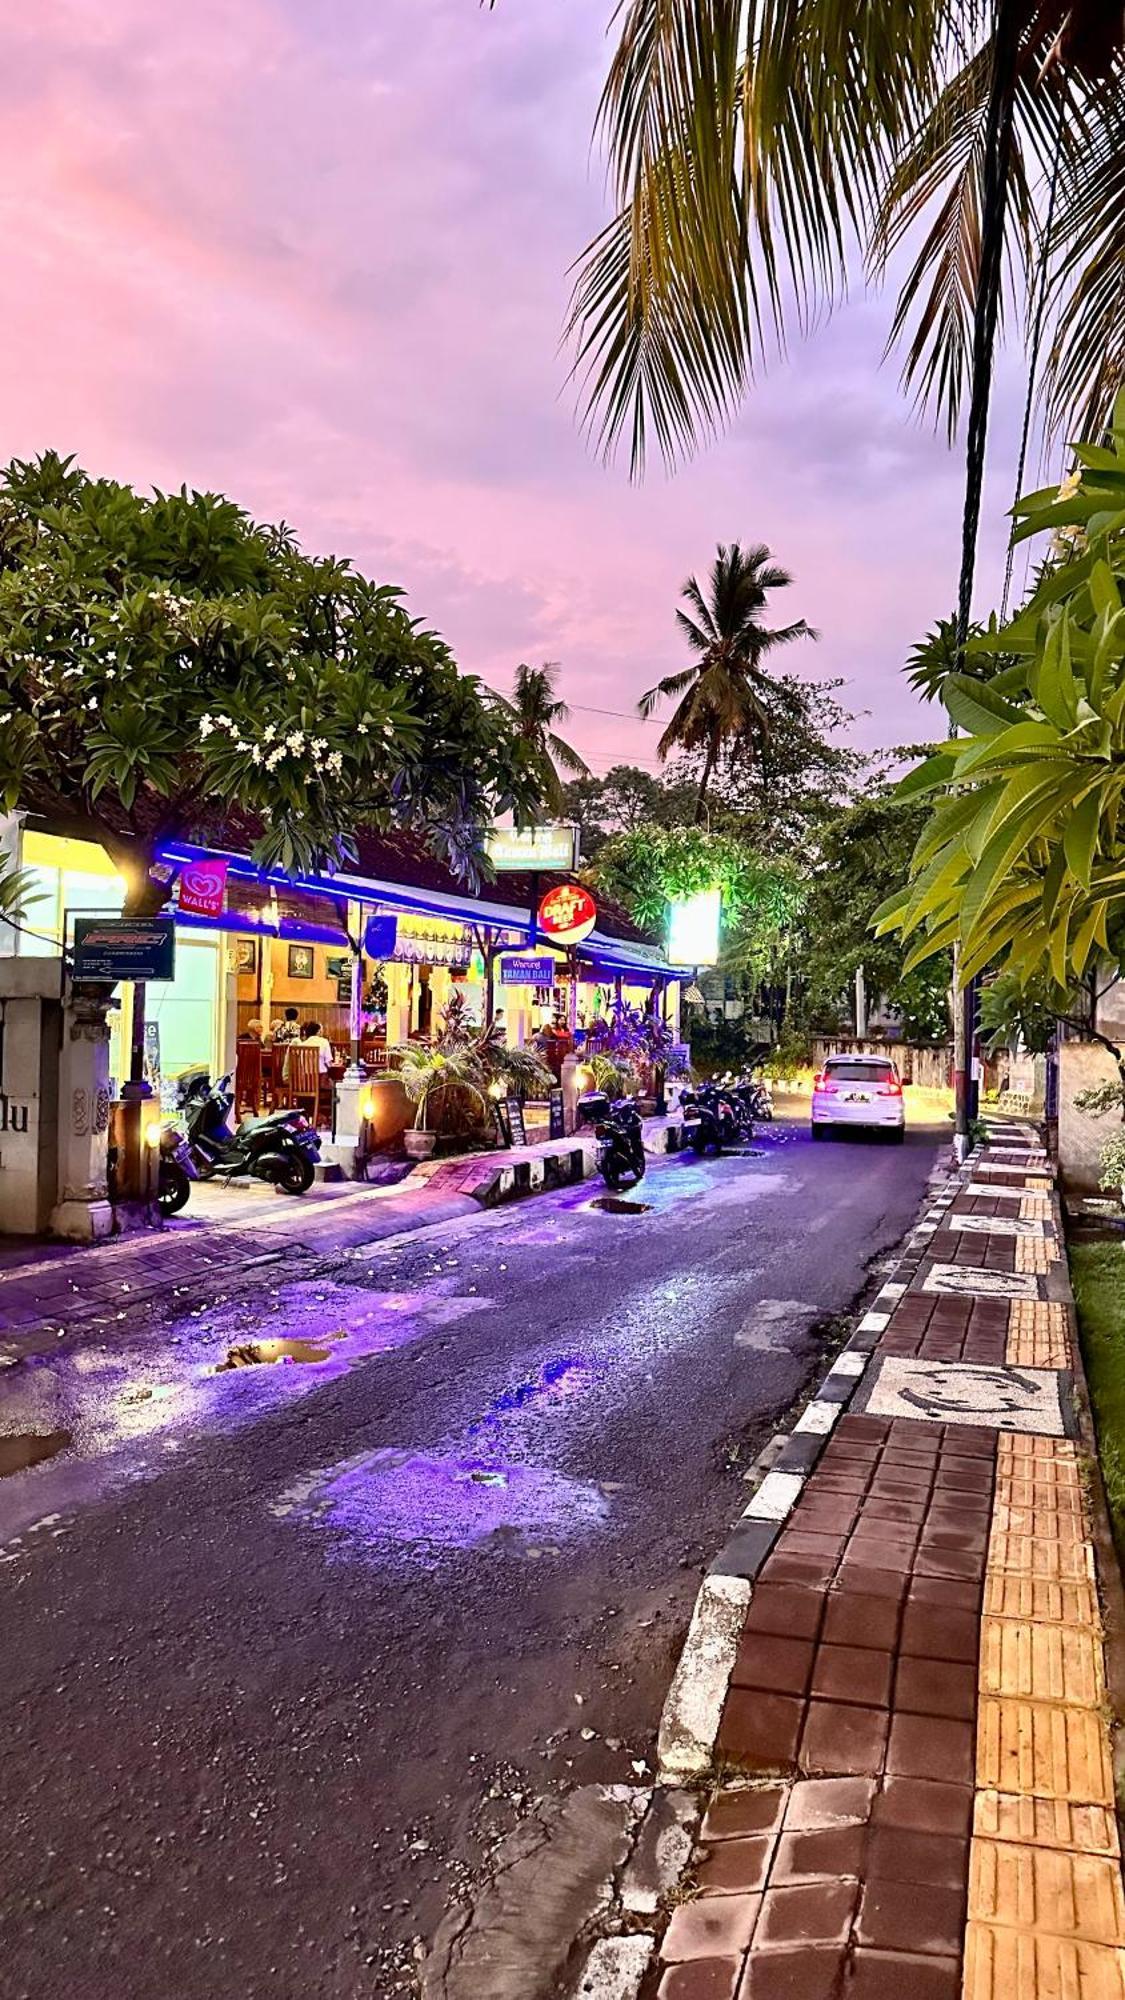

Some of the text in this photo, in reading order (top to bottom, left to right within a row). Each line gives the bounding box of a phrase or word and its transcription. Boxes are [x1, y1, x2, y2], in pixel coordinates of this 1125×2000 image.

[182, 894, 217, 911] WALL'S
[544, 898, 586, 919] DRAFT
[512, 958, 541, 970] Warung
[503, 969, 551, 980] TAMAN BALI
